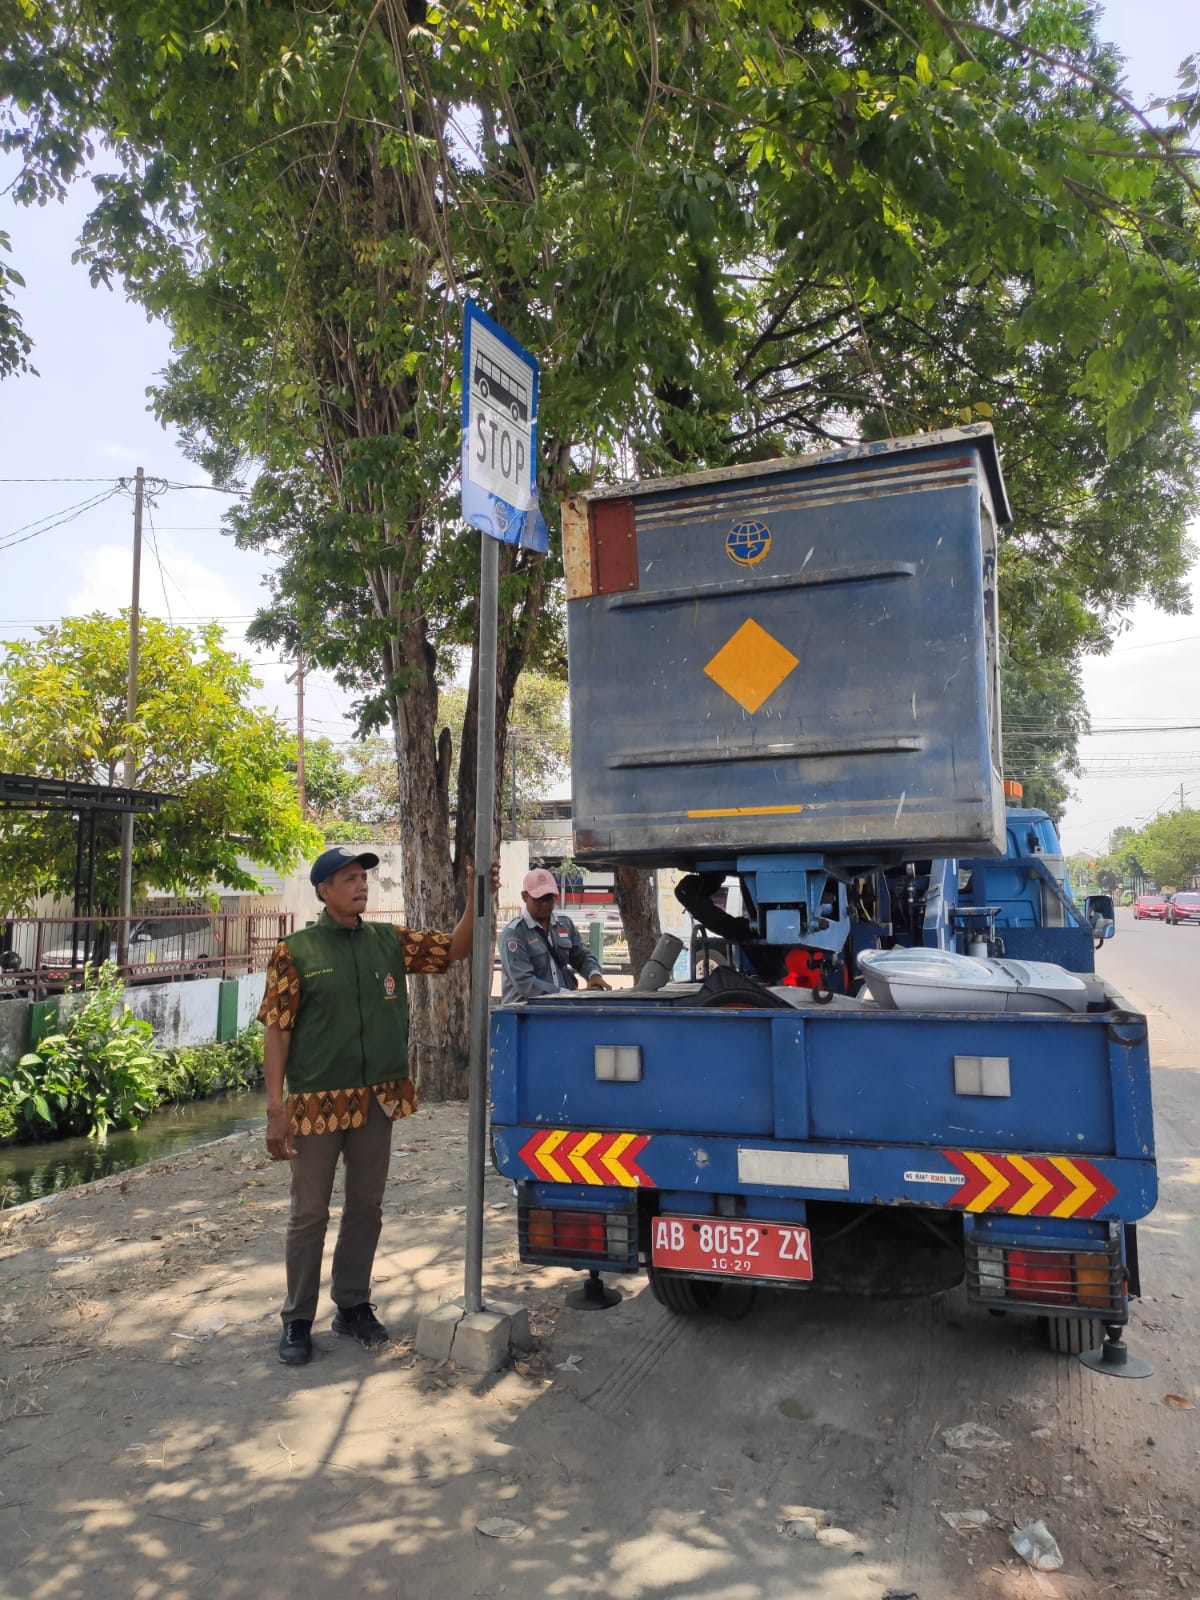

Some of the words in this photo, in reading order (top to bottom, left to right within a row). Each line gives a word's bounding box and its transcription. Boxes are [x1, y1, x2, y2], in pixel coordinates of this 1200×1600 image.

[476, 412, 525, 485] STOP
[930, 1174, 947, 1182] ROADS
[655, 1221, 684, 1251] AB
[699, 1224, 760, 1257] 8052
[778, 1230, 809, 1261] ZX
